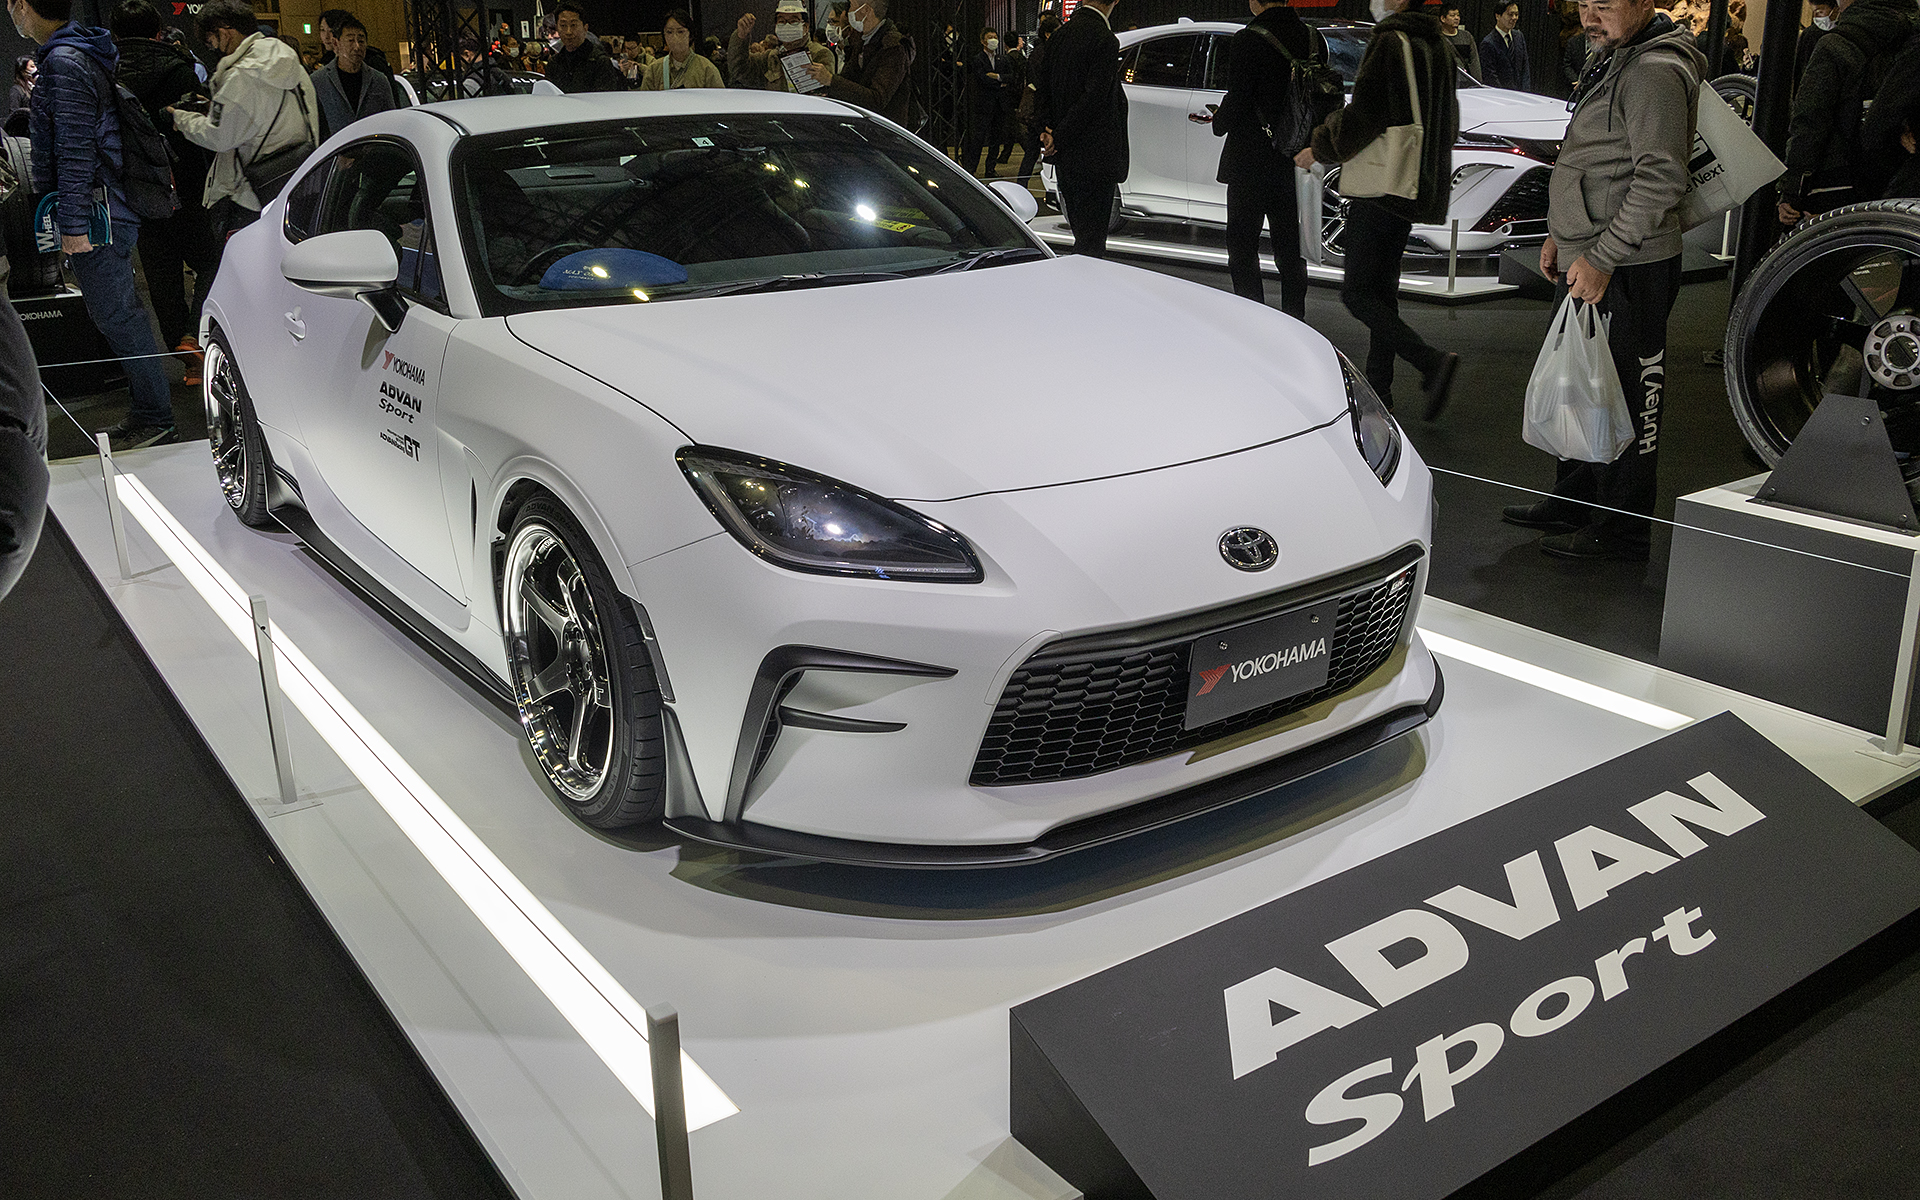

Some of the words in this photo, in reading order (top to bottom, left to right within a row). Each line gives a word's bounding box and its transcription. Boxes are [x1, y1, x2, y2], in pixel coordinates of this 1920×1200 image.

[1691, 163, 1725, 188] Next
[20, 310, 63, 320] OKOHAMA
[393, 357, 426, 386] YOKOHAMA
[378, 398, 415, 423] Sport
[379, 381, 422, 413] ADVAN
[1639, 381, 1662, 455] Hurley
[404, 434, 420, 461] GT
[1231, 638, 1327, 683] YOKOHAMA
[1224, 771, 1767, 1080] ADVAN
[1305, 906, 1717, 1167] Sport
